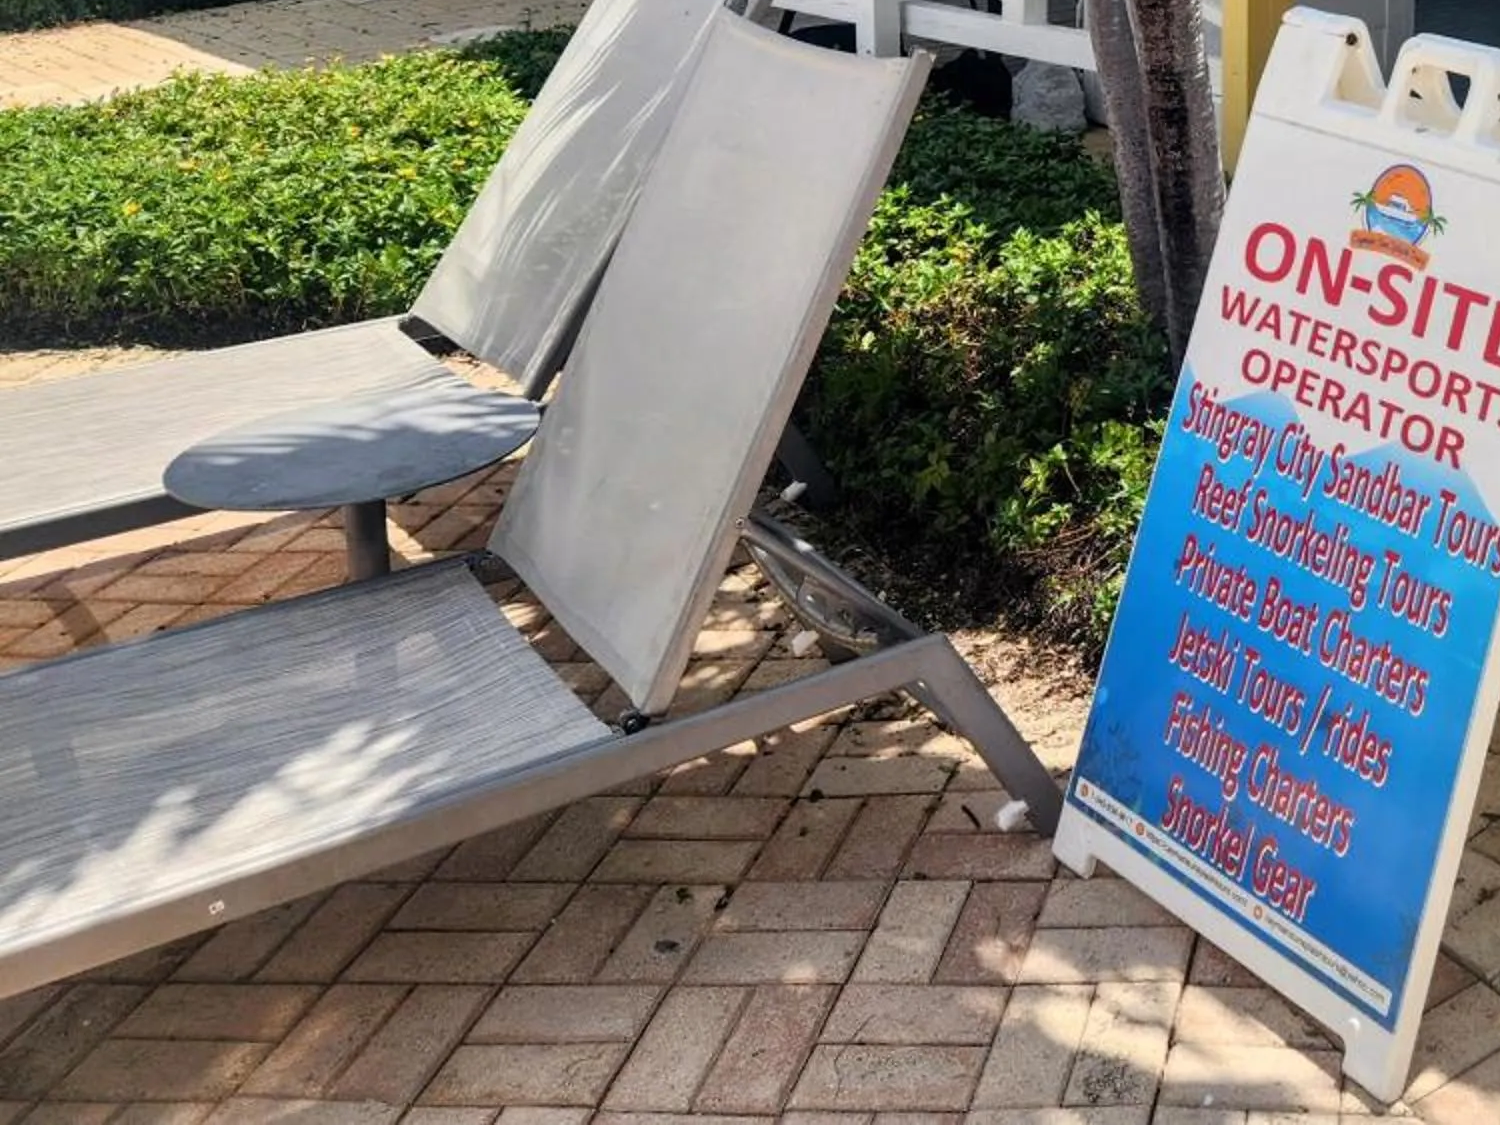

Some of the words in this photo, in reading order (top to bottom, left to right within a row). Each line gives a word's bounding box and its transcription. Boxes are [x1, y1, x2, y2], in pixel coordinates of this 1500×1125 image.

[1182, 380, 1276, 477] Stingray
[1275, 423, 1324, 502] City
[1323, 443, 1431, 538] Sandbar
[1241, 348, 1465, 470] OPERATOR
[1175, 534, 1257, 620] Private
[1257, 577, 1319, 657] Boat
[1319, 610, 1429, 717] Charters
[1192, 463, 1249, 536] Reef
[1246, 488, 1375, 611] Snorkeling
[1377, 550, 1453, 638] Tours
[1164, 691, 1247, 802] Fishing
[1247, 743, 1357, 858] Charters
[1168, 612, 1240, 695] Jetski
[1237, 647, 1307, 737] Tours
[1299, 683, 1332, 756] /
[1323, 706, 1392, 789] rides
[1161, 775, 1255, 883] Snorkel
[1252, 835, 1319, 923] Gear
